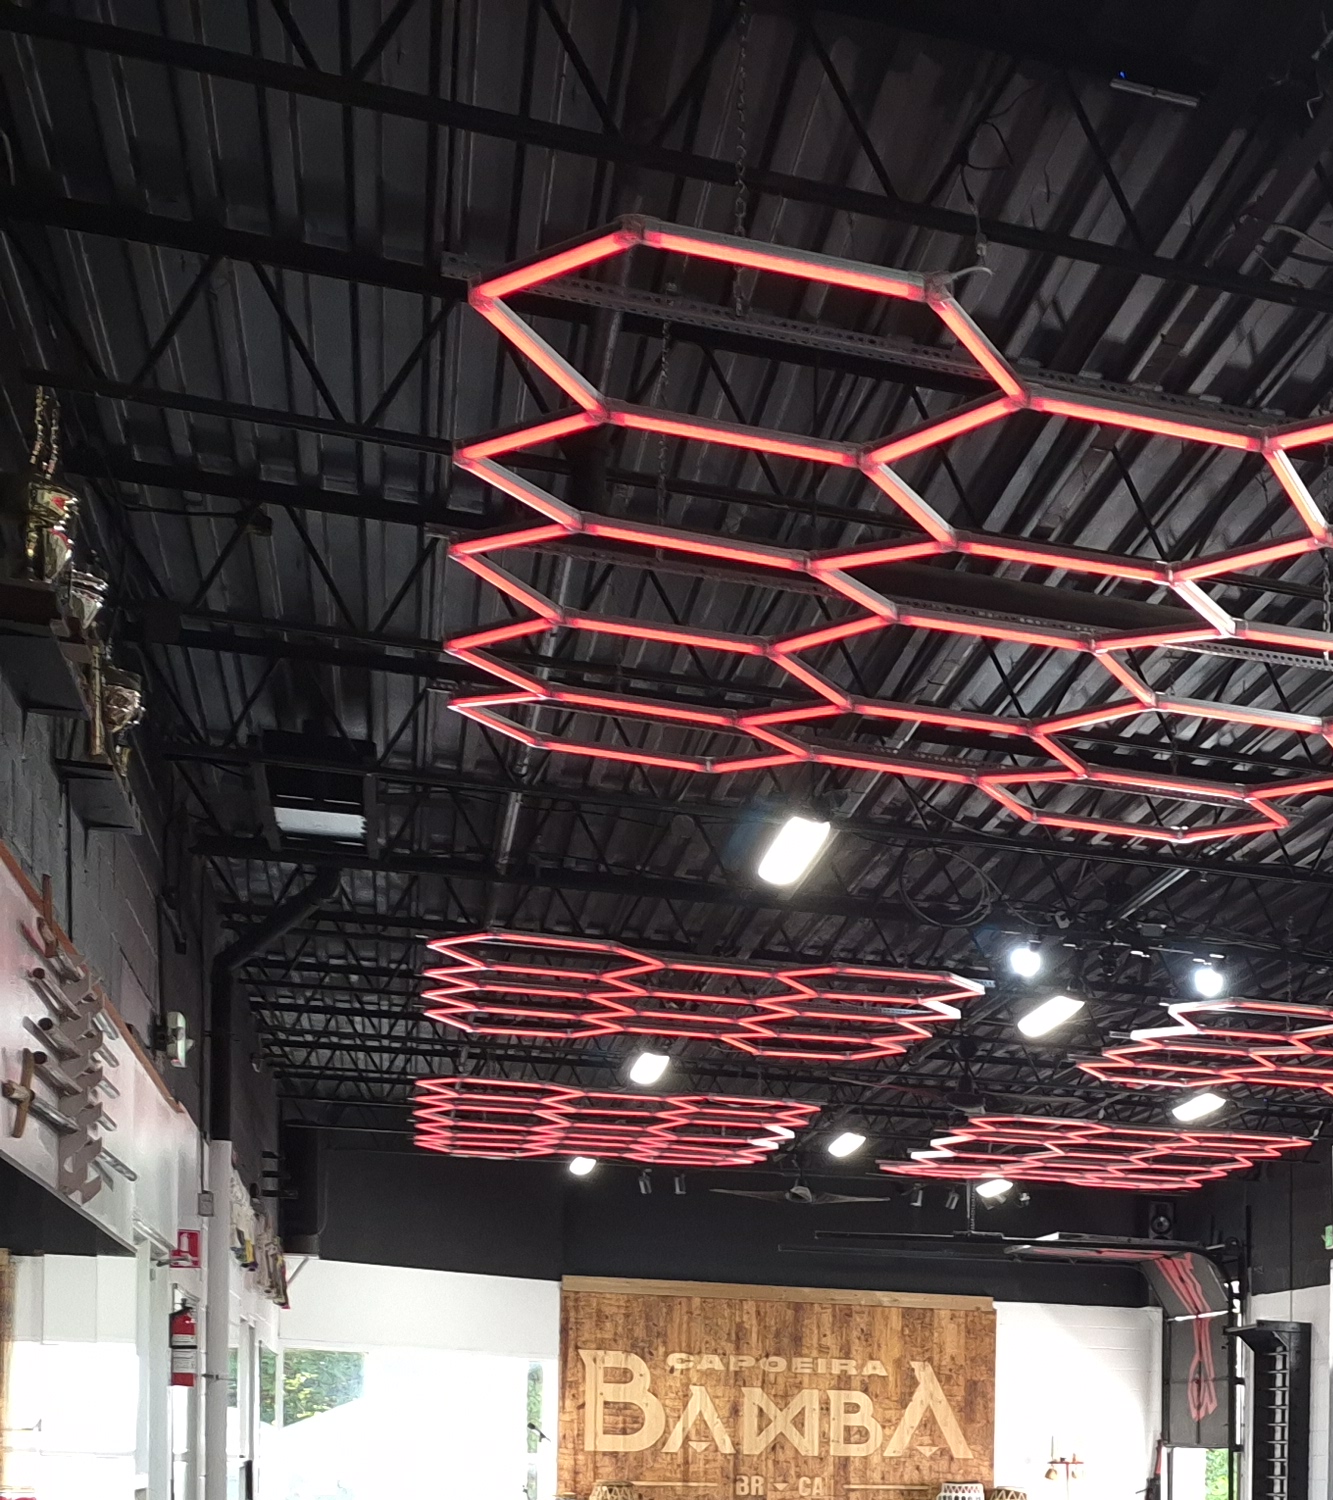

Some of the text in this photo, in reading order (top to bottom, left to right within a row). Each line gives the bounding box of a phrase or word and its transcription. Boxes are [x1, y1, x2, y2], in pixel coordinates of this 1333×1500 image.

[666, 1352, 888, 1377] CAPOEIRA
[578, 1349, 974, 1459] BAMBA
[736, 1475, 825, 1497] BR CA
